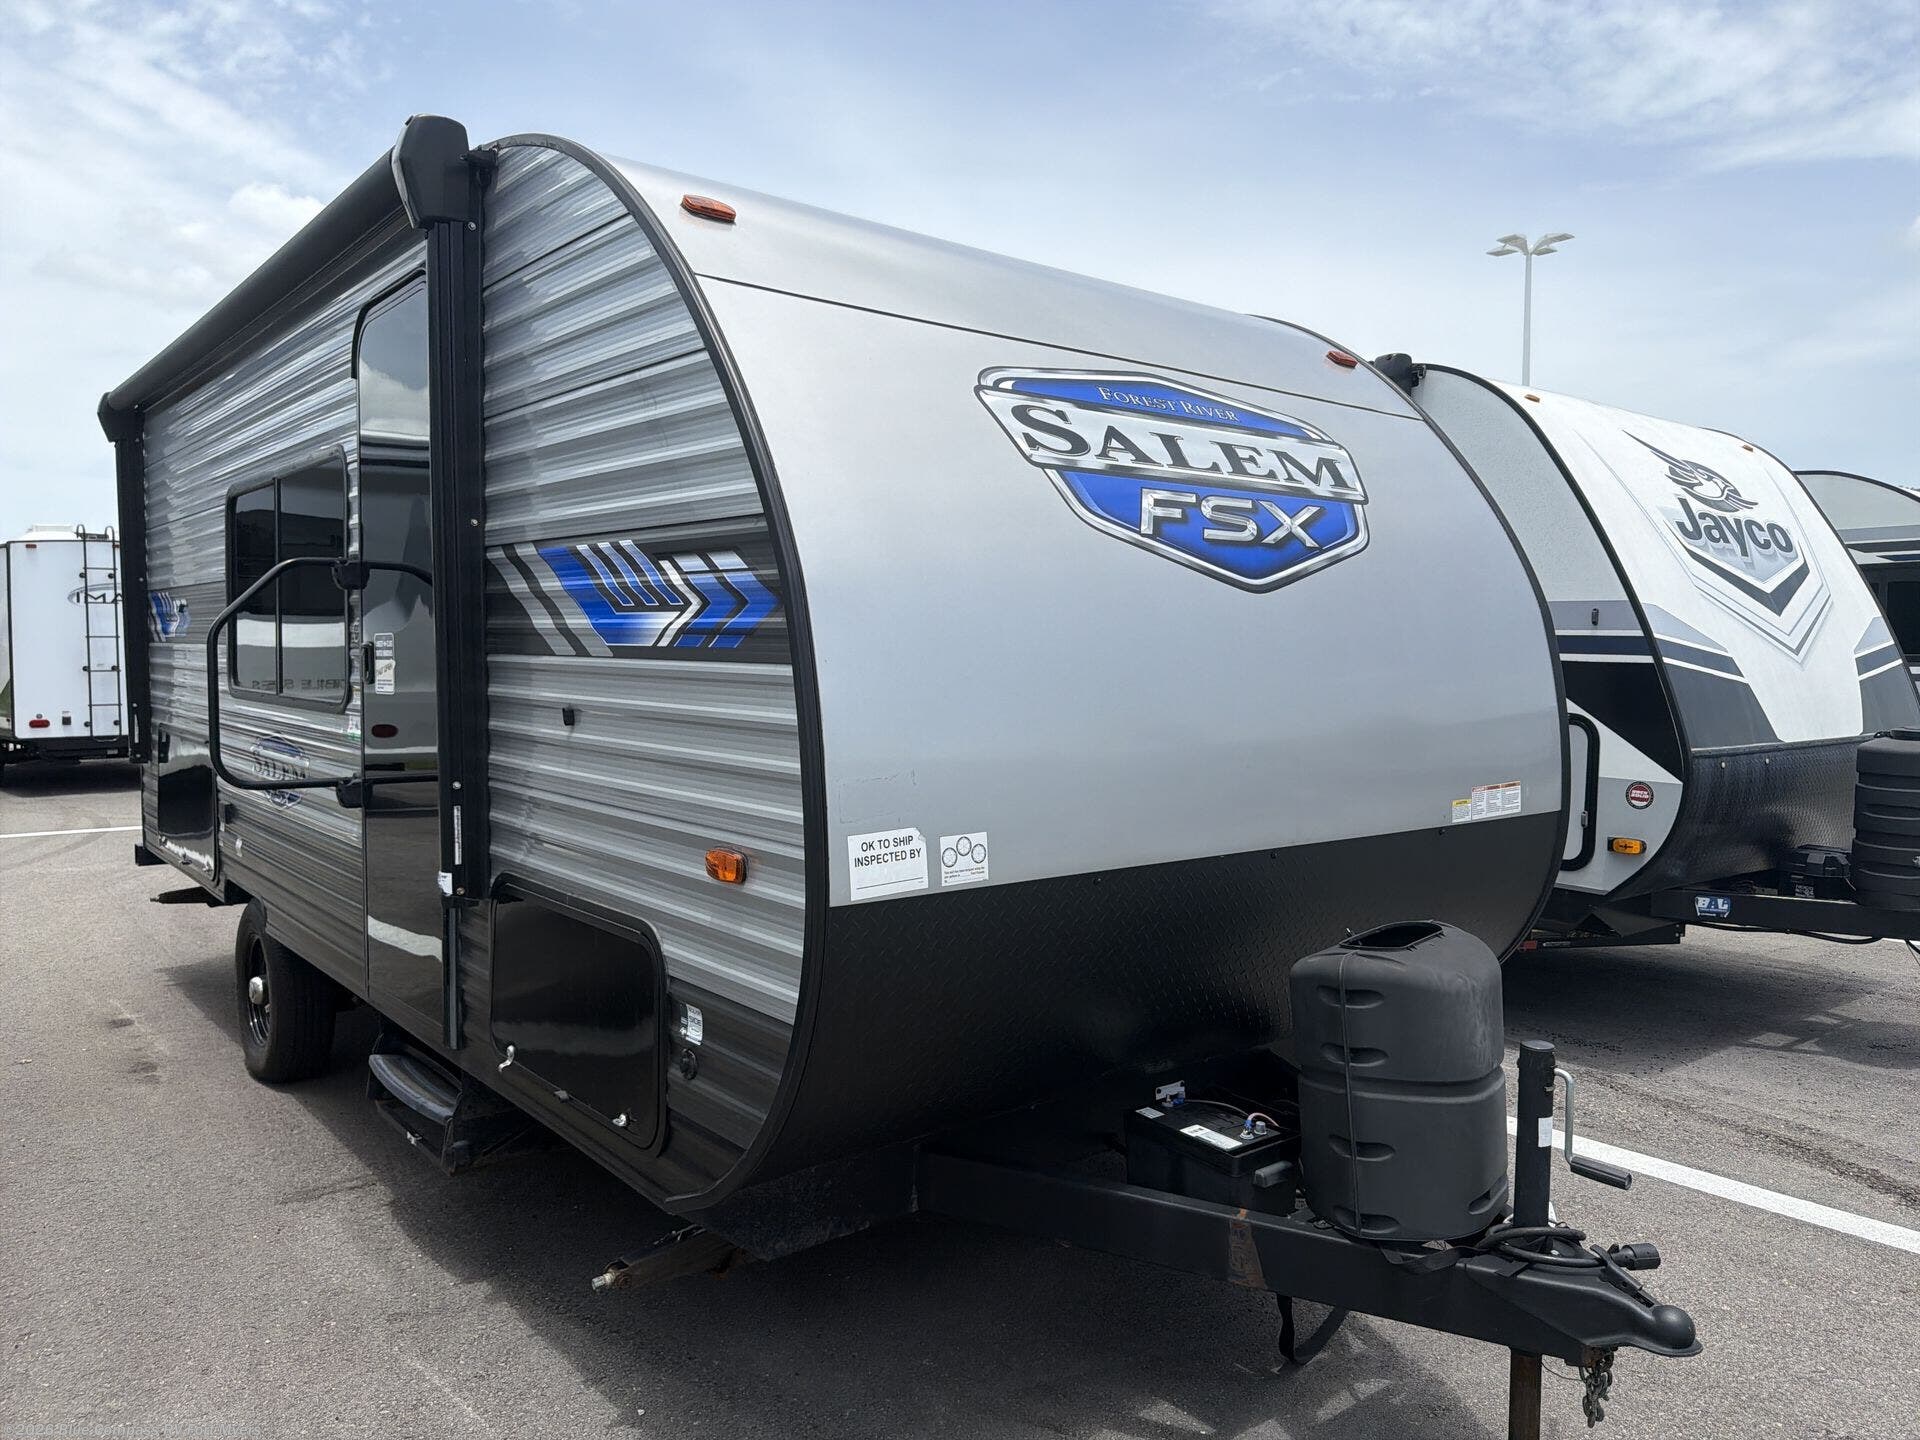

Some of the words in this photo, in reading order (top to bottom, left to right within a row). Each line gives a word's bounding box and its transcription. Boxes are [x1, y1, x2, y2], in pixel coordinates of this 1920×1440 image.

[1097, 385, 1177, 411] FOREST
[1179, 400, 1240, 421] RIVER
[1010, 404, 1359, 491] SALEM
[1139, 487, 1327, 549] FSX
[1674, 496, 1794, 557] Jayco
[854, 850, 908, 867] INSPECTED
[909, 848, 922, 859] BY
[861, 841, 876, 852] OK
[877, 838, 891, 850] TO
[892, 835, 914, 848] SHIP
